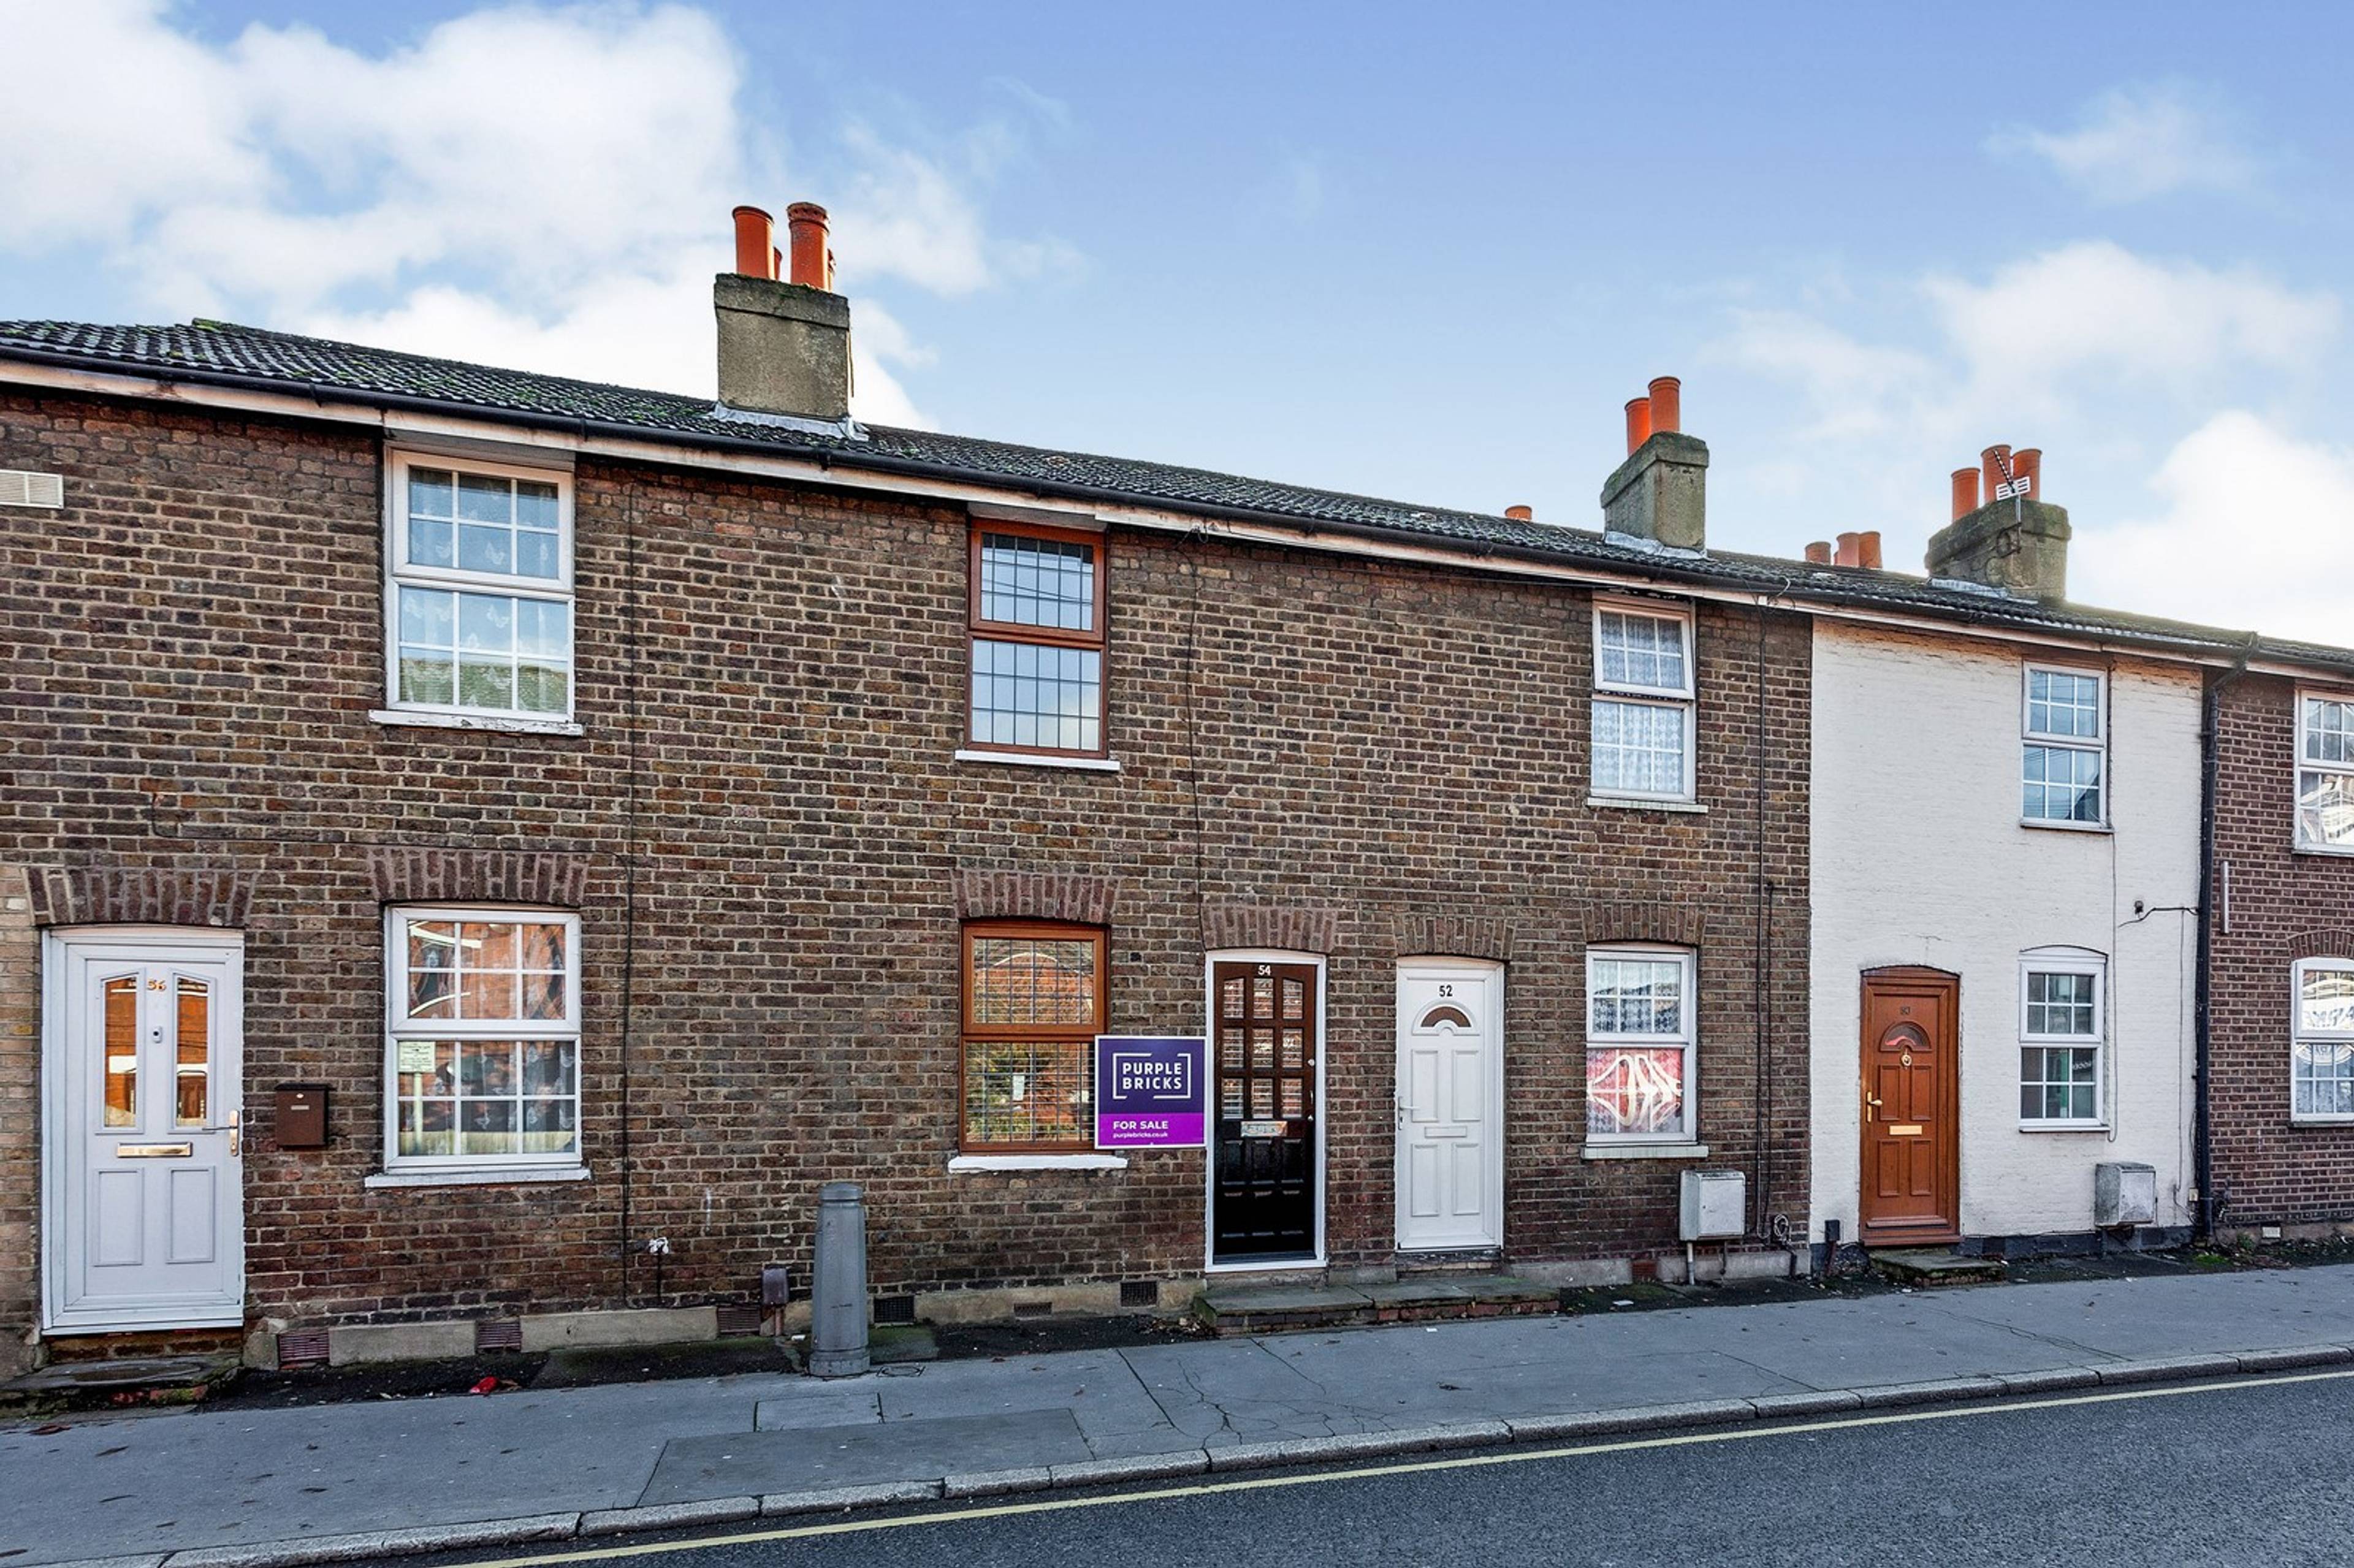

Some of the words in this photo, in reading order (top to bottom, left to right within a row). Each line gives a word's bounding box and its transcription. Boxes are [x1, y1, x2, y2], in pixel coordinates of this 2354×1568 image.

[1258, 965, 1271, 976] 54
[1439, 984, 1453, 997] 52
[1122, 1062, 1182, 1075] PURPLE
[1122, 1076, 1182, 1089] BRICKS
[1113, 1121, 1137, 1129] FOR
[1140, 1121, 1168, 1129] SALE
